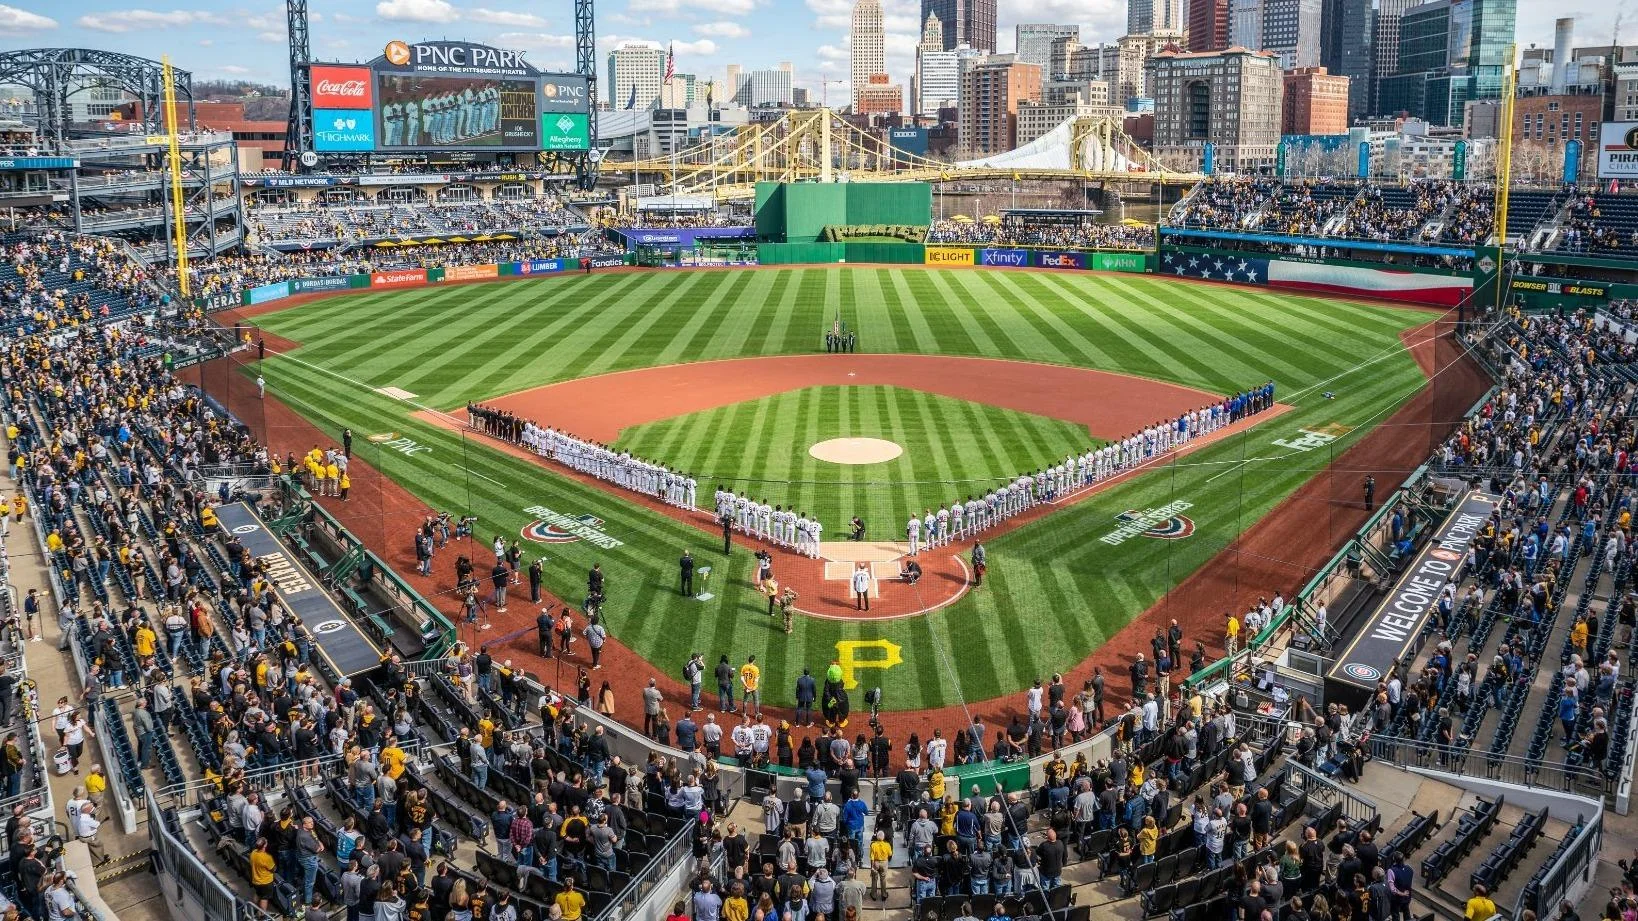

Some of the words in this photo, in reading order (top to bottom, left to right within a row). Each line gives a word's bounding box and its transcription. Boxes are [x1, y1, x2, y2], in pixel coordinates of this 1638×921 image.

[414, 45, 466, 66] PNC
[469, 48, 527, 69] PARK
[558, 85, 584, 97] PNC
[549, 135, 582, 143] Allegheny
[278, 178, 294, 186] MLB
[294, 178, 329, 186] NETWORK
[591, 259, 623, 268] Fanatics
[942, 253, 970, 261] LIGHT
[985, 251, 1023, 265] xfinity
[1042, 255, 1075, 266] FedEx
[1115, 259, 1136, 268] AHN
[532, 262, 558, 271] LUMBER
[1512, 281, 1547, 290] BOWSER
[1570, 286, 1604, 296] BLASTS
[206, 292, 242, 311] AERAS
[1453, 512, 1484, 536] PARK
[568, 526, 625, 549] SERIES
[1438, 528, 1469, 553] PNC
[255, 551, 313, 595] PIRATES
[1419, 560, 1452, 577] TO
[1371, 575, 1442, 643] WELCOME
[835, 639, 904, 690] P
[70, 806, 78, 816] 21
